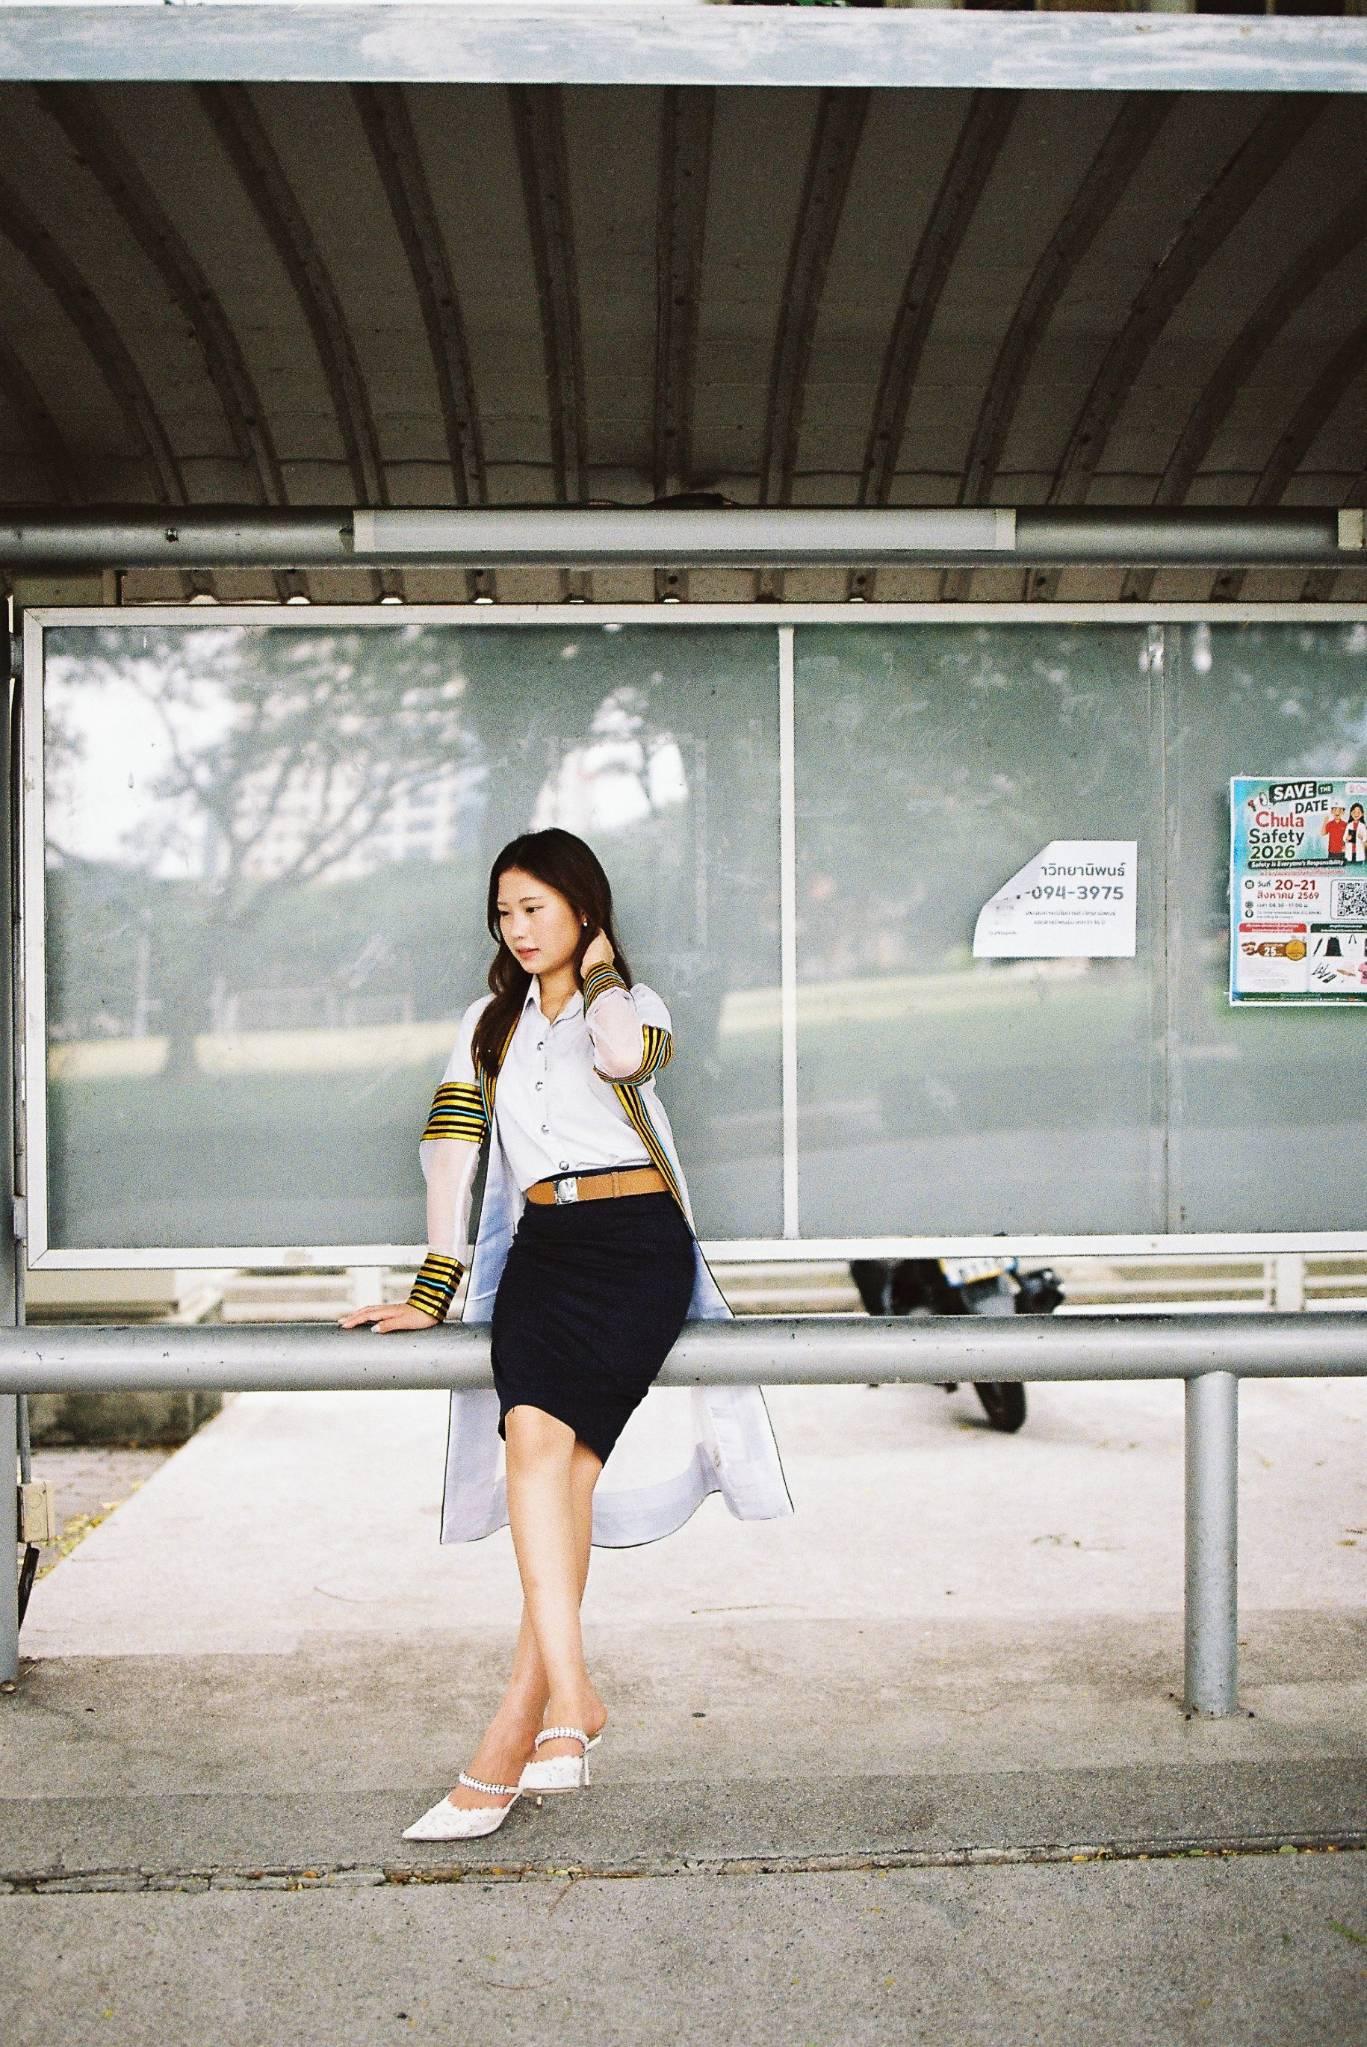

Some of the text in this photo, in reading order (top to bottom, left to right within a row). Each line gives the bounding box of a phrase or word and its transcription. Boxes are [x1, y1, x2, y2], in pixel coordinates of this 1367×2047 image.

[1273, 783, 1314, 800] SAVE
[1295, 800, 1329, 814] DATE
[1256, 811, 1304, 827] Chula
[1249, 829, 1305, 845] Safety
[1250, 845, 1296, 859] 2026
[1275, 880, 1316, 890] 20-21
[1298, 891, 1320, 899] 2569
[1264, 947, 1277, 956] 25
